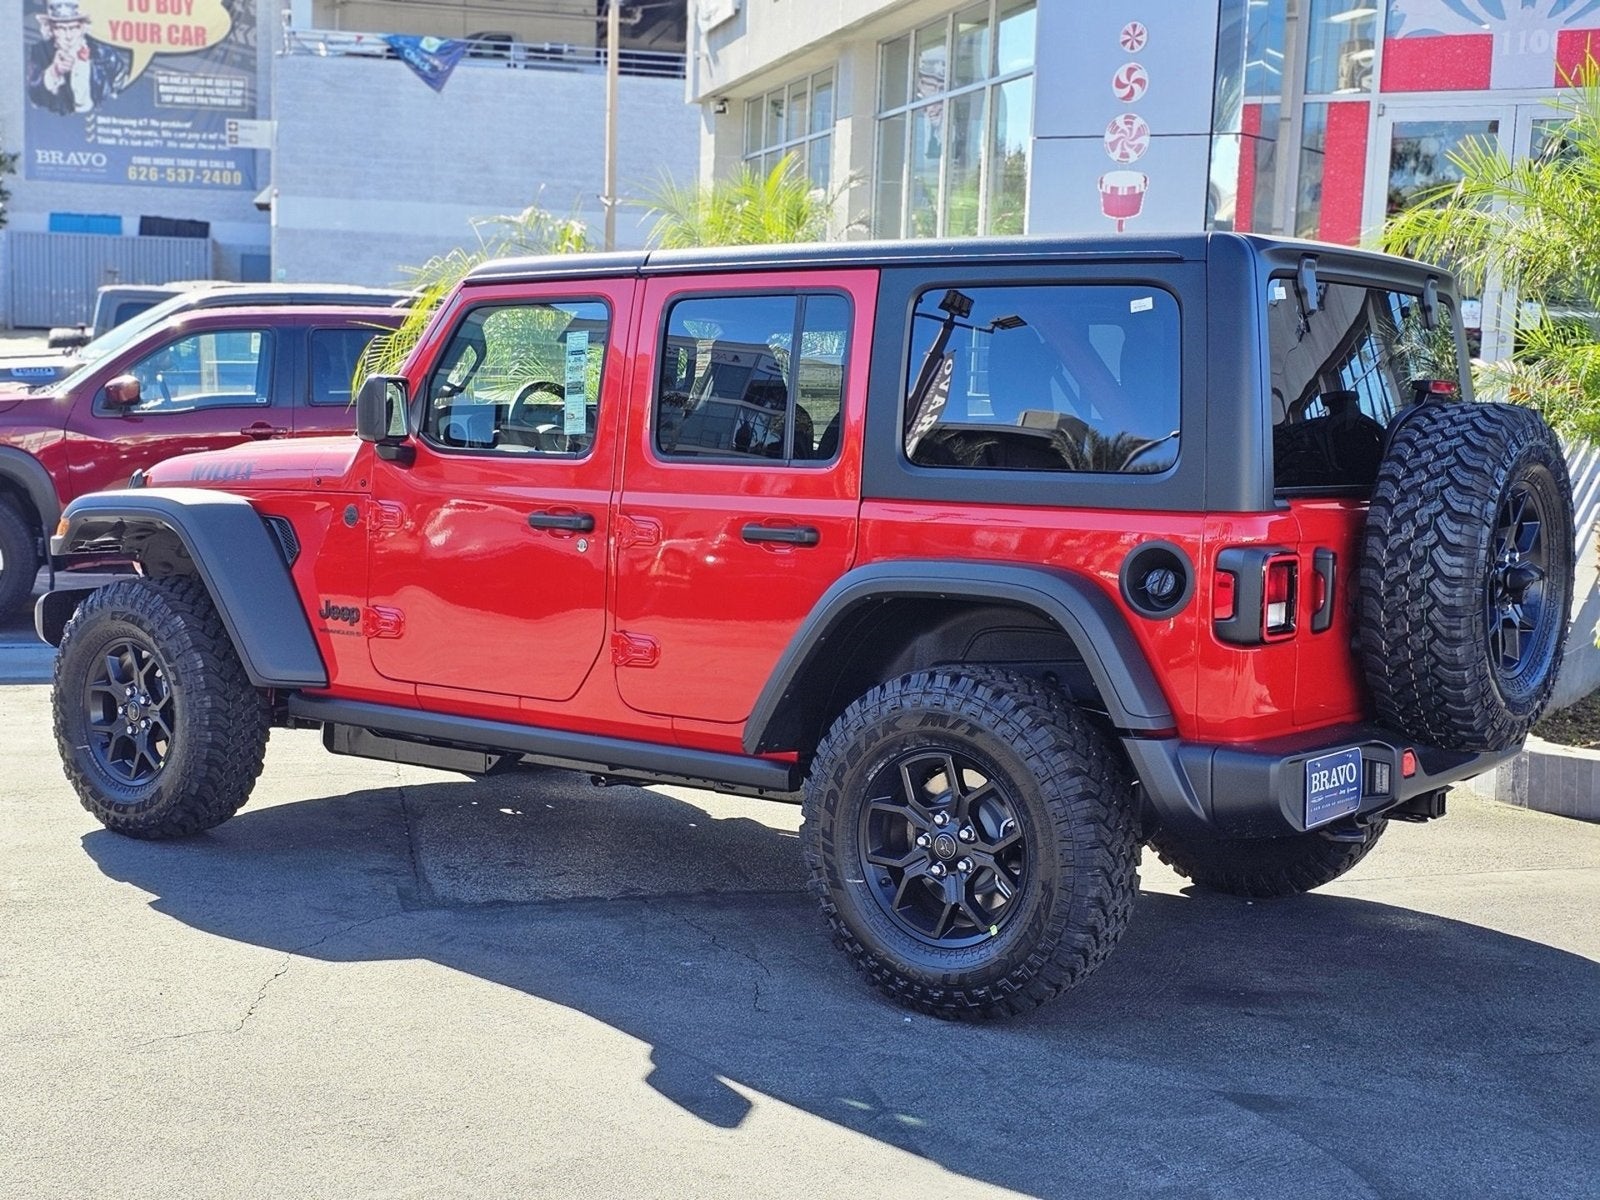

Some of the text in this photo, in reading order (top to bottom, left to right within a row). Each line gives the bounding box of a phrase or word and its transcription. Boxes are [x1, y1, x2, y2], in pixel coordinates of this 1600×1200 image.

[126, 0, 194, 15] TO BUY
[108, 20, 207, 46] YOUR CAR
[1503, 28, 1556, 55] 110
[35, 149, 107, 167] BRAVO
[128, 165, 242, 186] 626-537-2400
[319, 600, 361, 627] Jeep
[1310, 762, 1357, 794] BRAVO
[822, 711, 986, 891] WILDPEAK M/T
